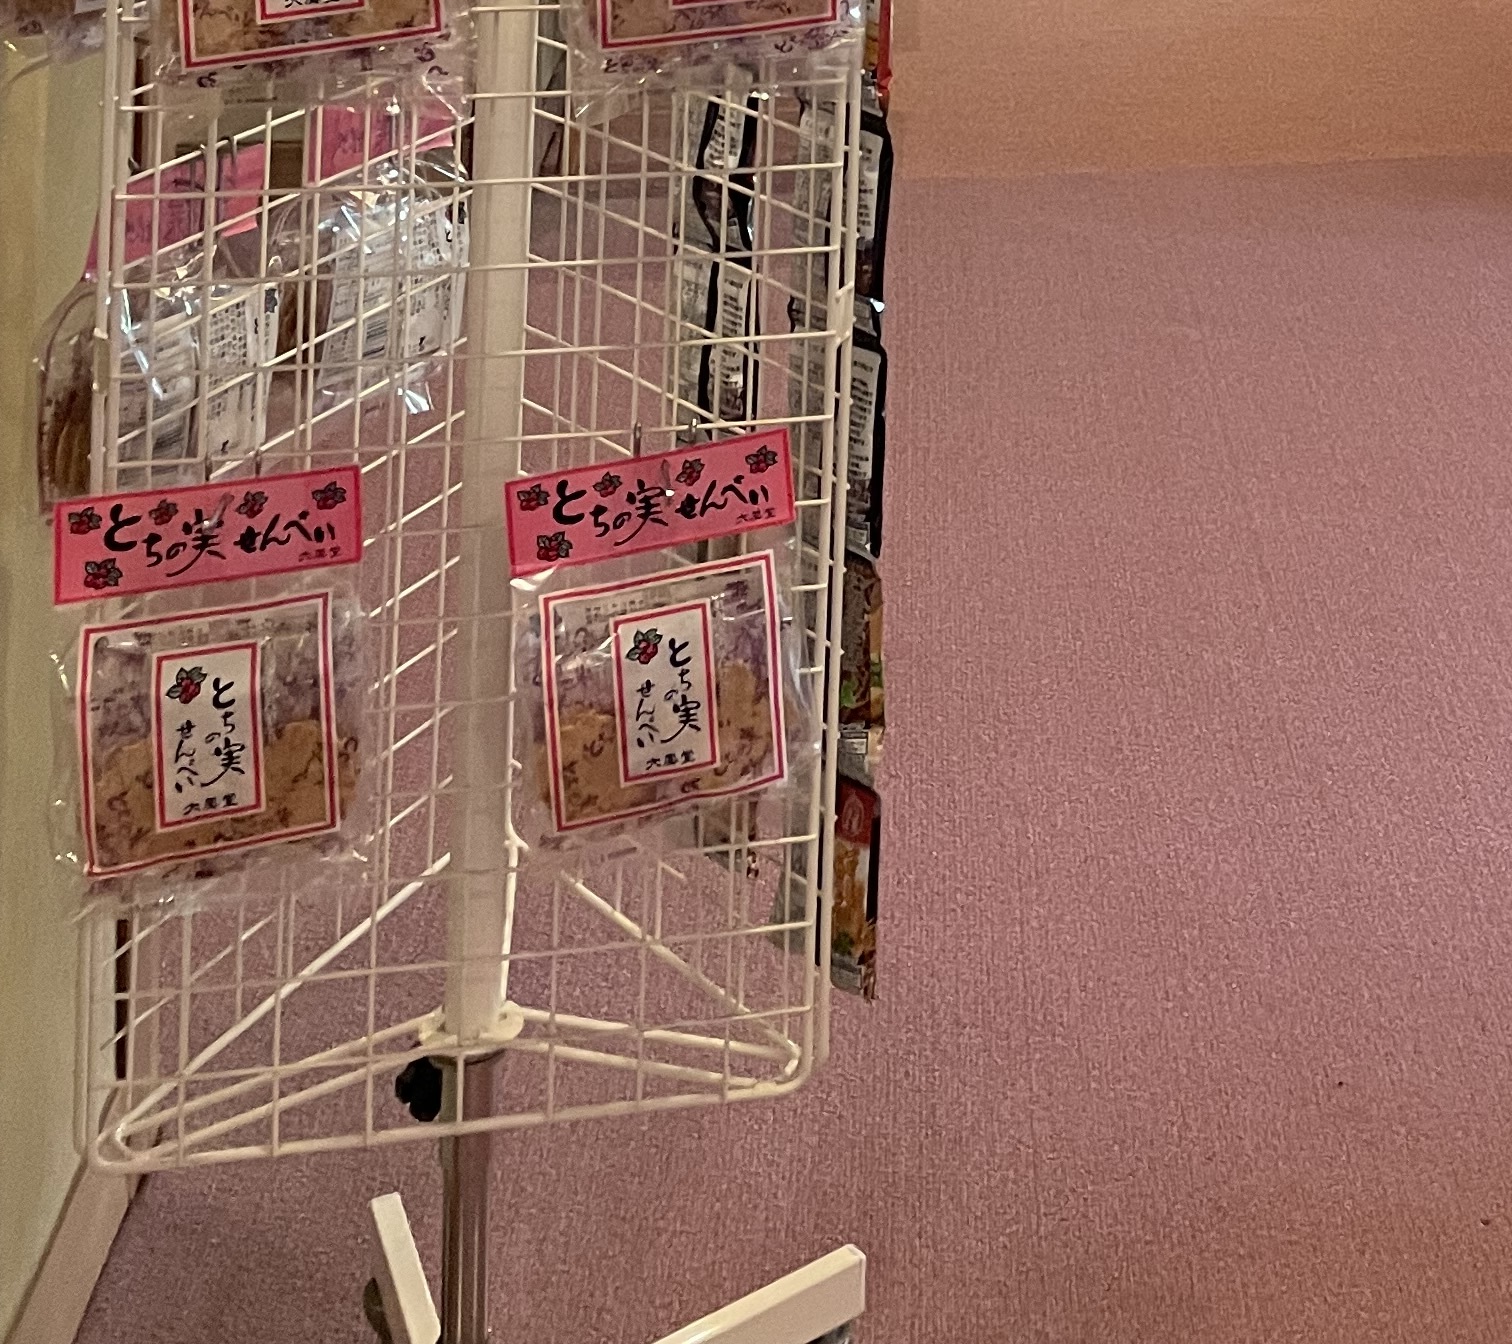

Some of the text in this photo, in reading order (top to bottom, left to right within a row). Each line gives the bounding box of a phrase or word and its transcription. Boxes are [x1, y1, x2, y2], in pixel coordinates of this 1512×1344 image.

[200, 677, 246, 788] とちの実
[636, 679, 660, 748] せんべい
[661, 637, 702, 744] とちの実
[174, 719, 196, 793] せんべい
